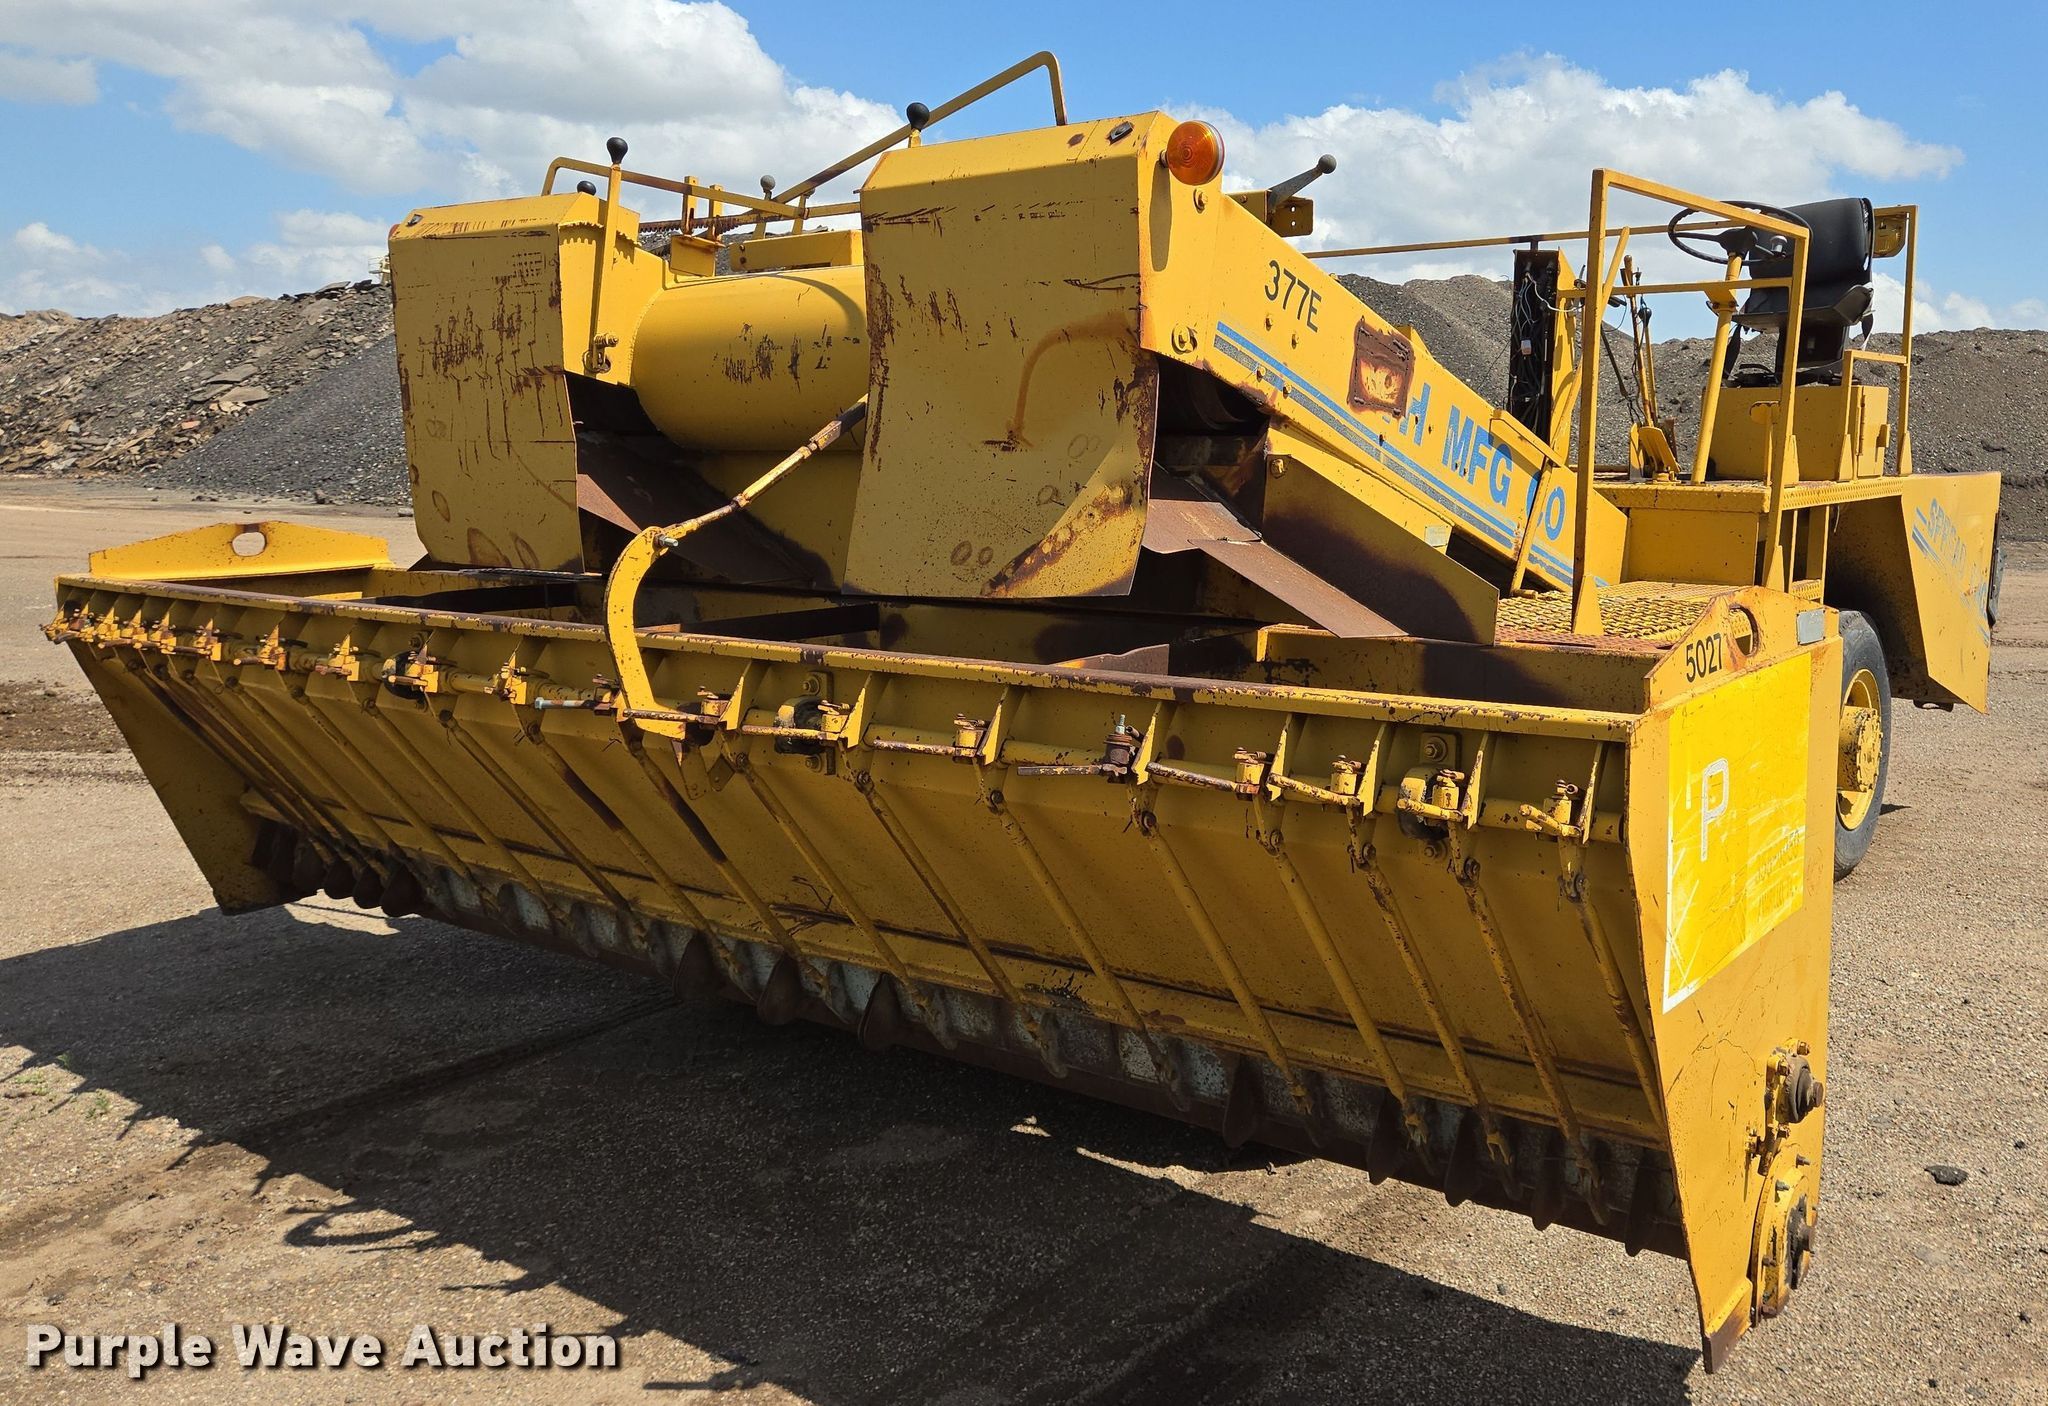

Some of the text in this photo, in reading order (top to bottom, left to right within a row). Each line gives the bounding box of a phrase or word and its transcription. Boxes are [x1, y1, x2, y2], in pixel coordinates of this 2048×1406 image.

[1264, 259, 1322, 333] 377E
[1442, 405, 1513, 507] MFG
[1685, 632, 1723, 684] 5027
